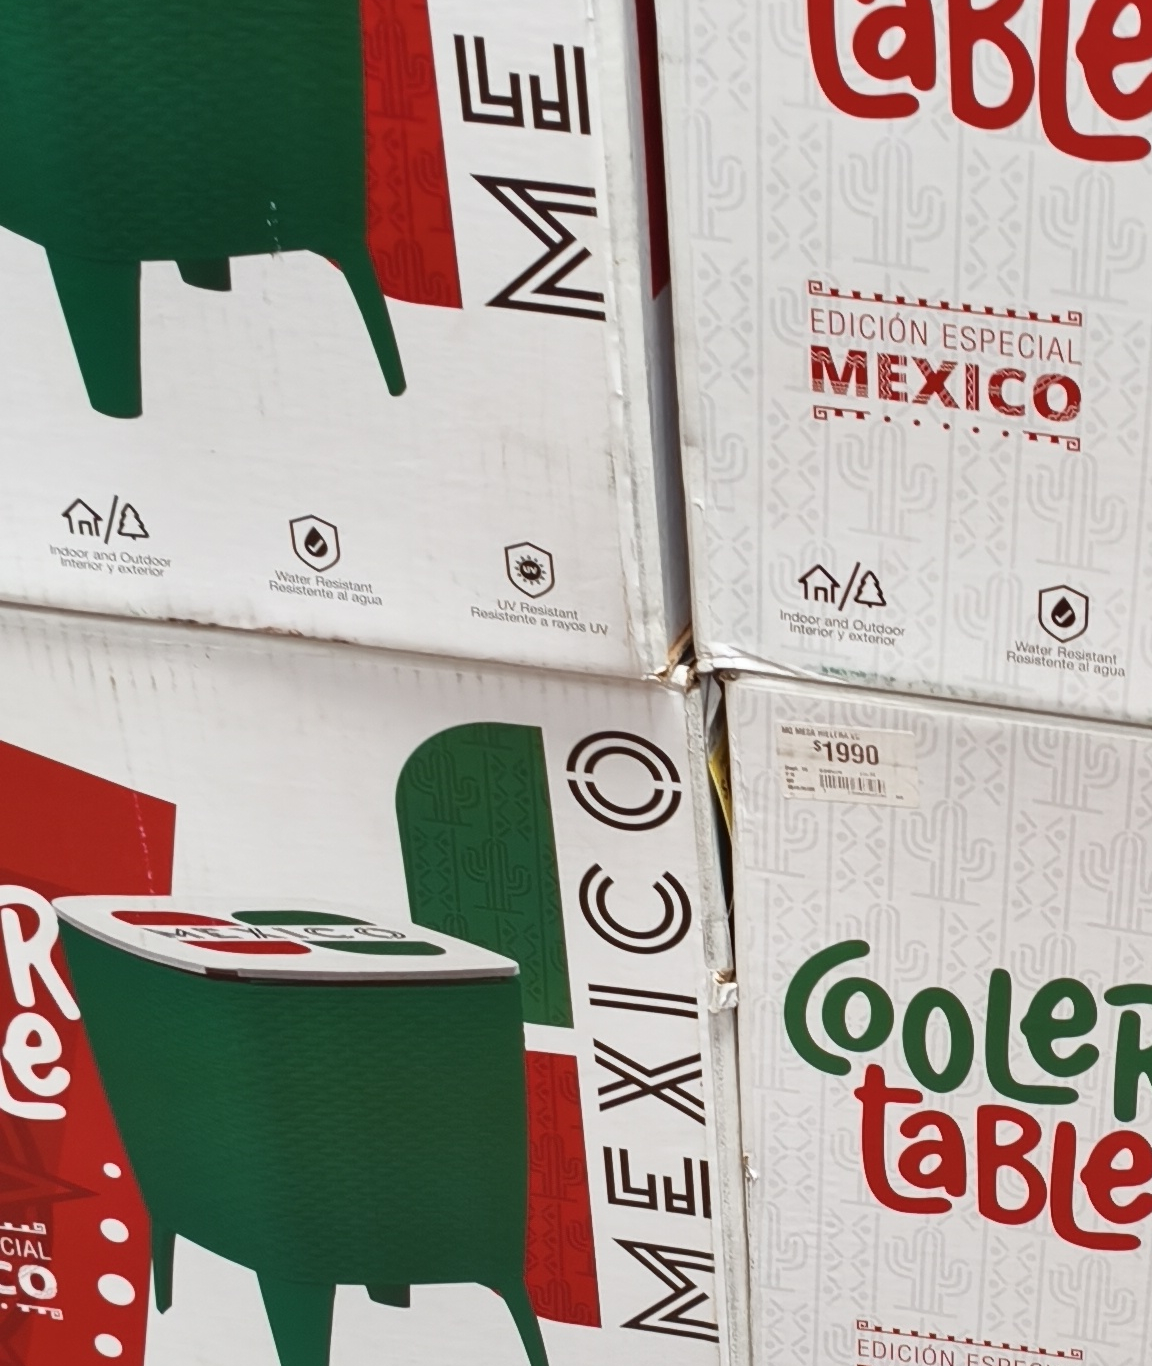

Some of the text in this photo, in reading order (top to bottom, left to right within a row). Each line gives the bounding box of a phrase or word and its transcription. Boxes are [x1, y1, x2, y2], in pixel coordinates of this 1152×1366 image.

[811, 307, 1082, 365] EDICIÓN ESPECIAL
[811, 344, 1082, 422] MEXICO
[50, 544, 171, 568] Indoor and Outdoor
[60, 556, 164, 577] Interior exterior
[269, 579, 383, 606] Resistente al agua
[275, 569, 373, 594] Water Resistant
[471, 606, 608, 636] Resistente rayos UV
[497, 599, 578, 620] UV Resistant
[779, 609, 905, 636] Indoor and Outdoor
[789, 622, 896, 646] Interior exterior
[1006, 651, 1125, 678] Resistente al agua
[1015, 641, 1117, 665] Water Resistant
[813, 739, 879, 765] $1990
[566, 730, 720, 1343] MEXICO
